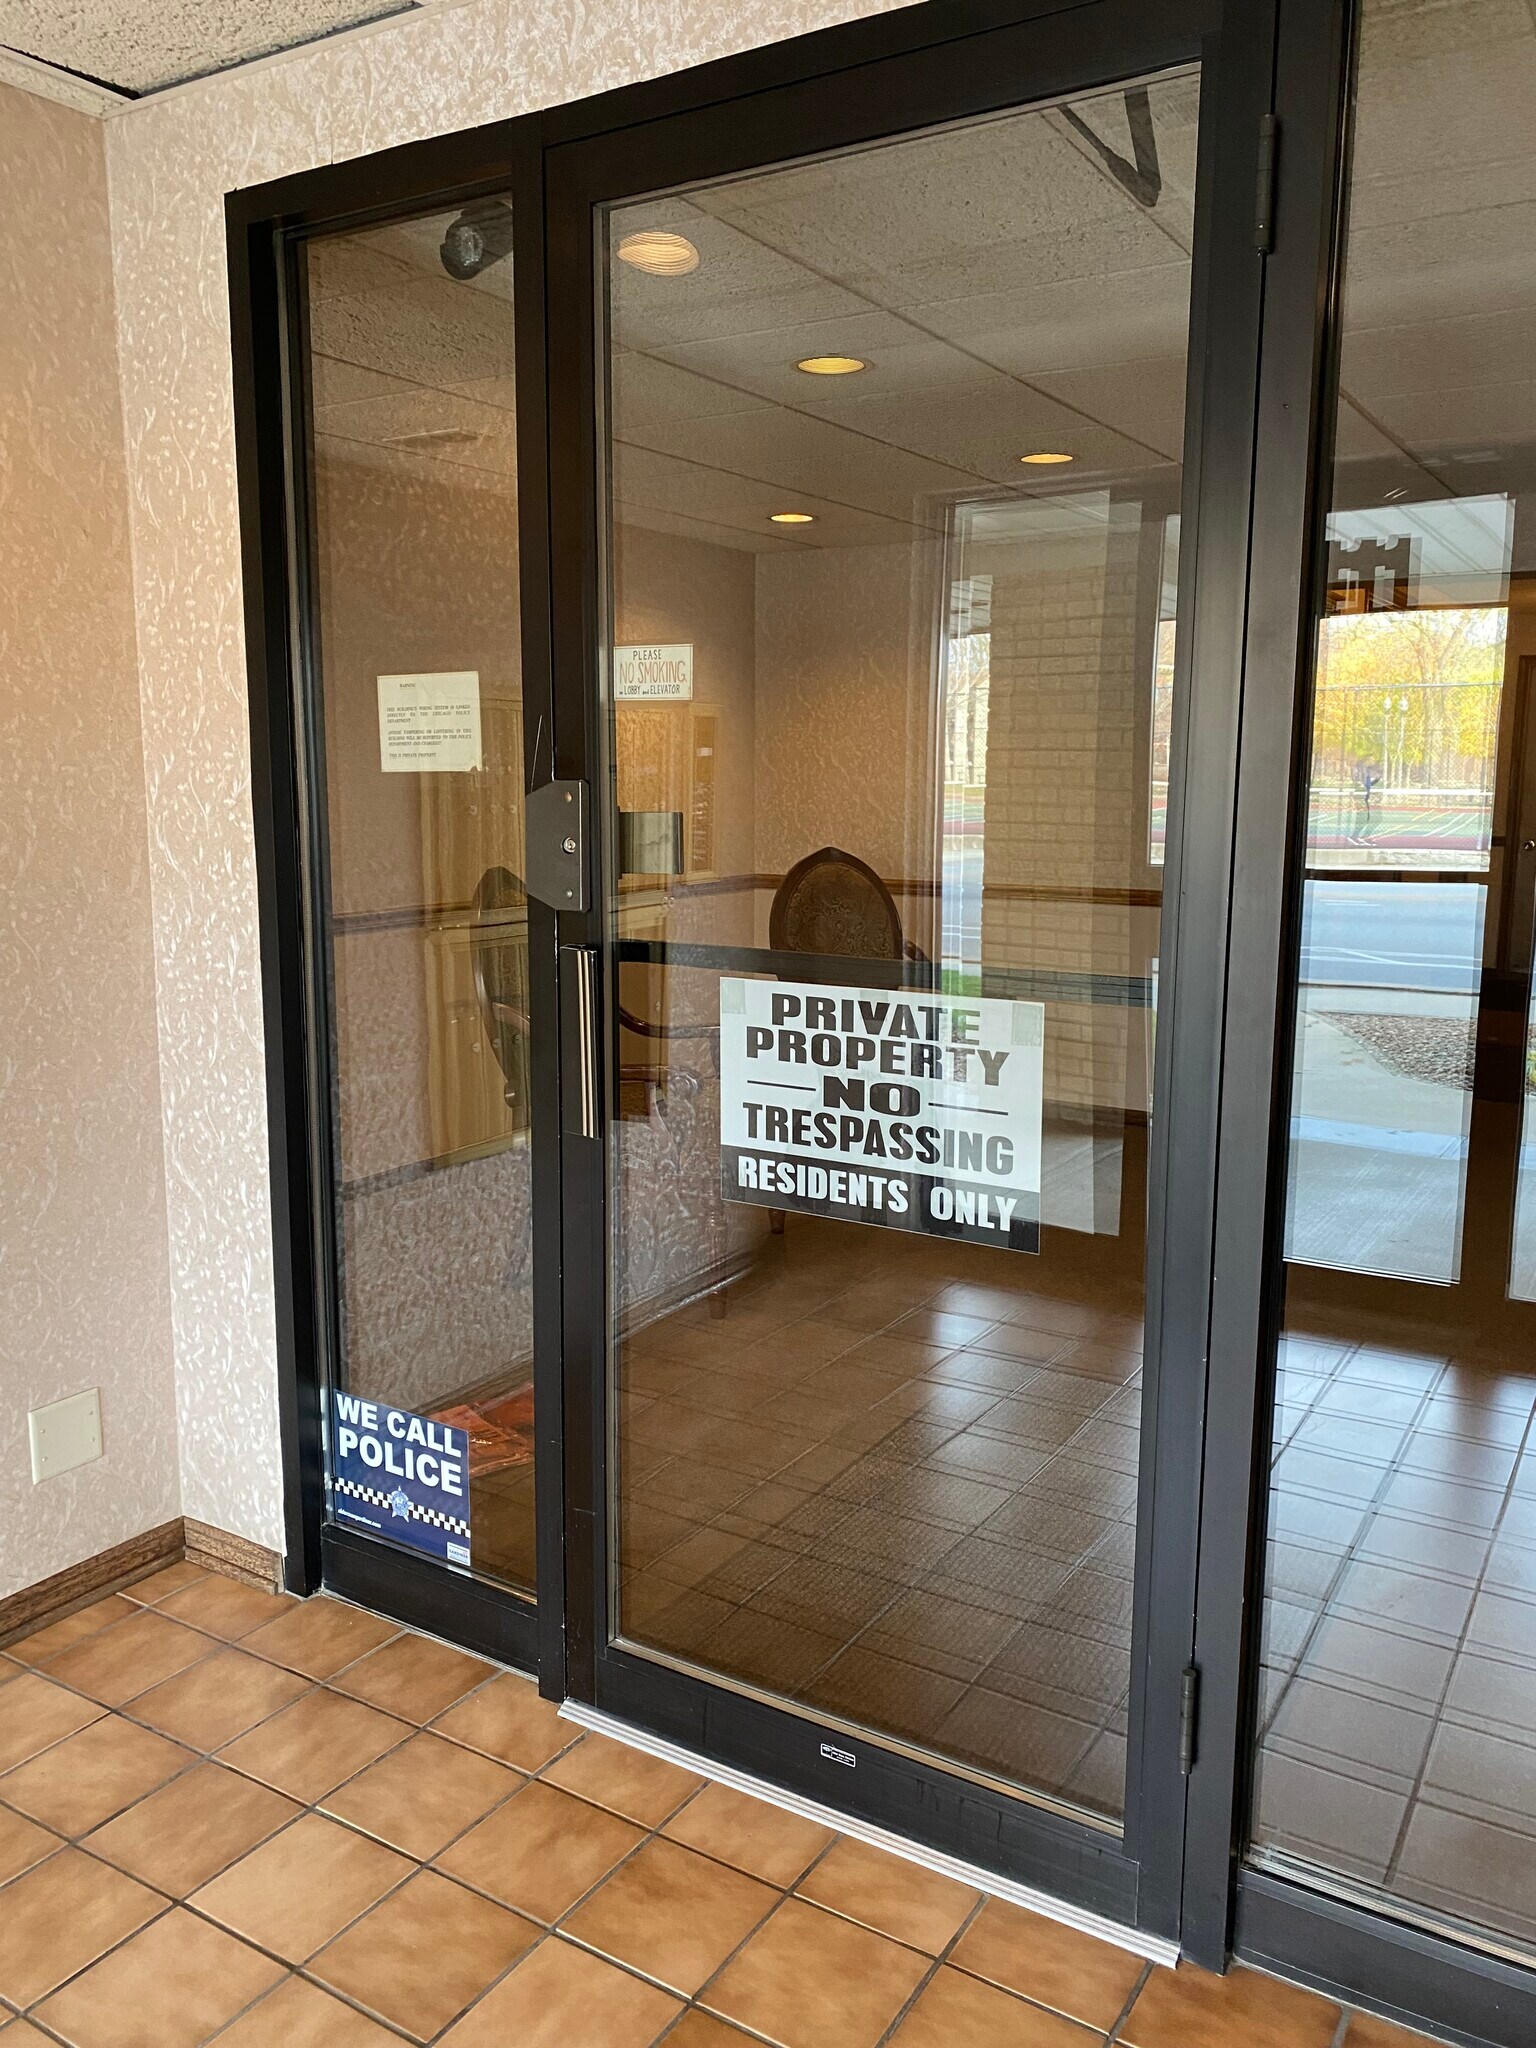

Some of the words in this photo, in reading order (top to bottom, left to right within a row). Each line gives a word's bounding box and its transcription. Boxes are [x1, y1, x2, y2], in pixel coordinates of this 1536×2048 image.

[620, 662, 634, 684] NO
[638, 660, 687, 683] SMOKING
[633, 649, 661, 660] PLEASE
[624, 685, 640, 695] LOBBY
[650, 684, 680, 694] ELEVATOR
[772, 993, 980, 1045] PRIVATE
[746, 1026, 1009, 1086] PROPERTY
[823, 1075, 921, 1117] NO
[743, 1102, 1014, 1175] TRESPASSING
[738, 1156, 909, 1213] RESIDENTS
[930, 1187, 1017, 1232] ONLY
[336, 1393, 378, 1431] WE
[387, 1411, 461, 1458] CALL
[339, 1427, 462, 1496] POLICE
